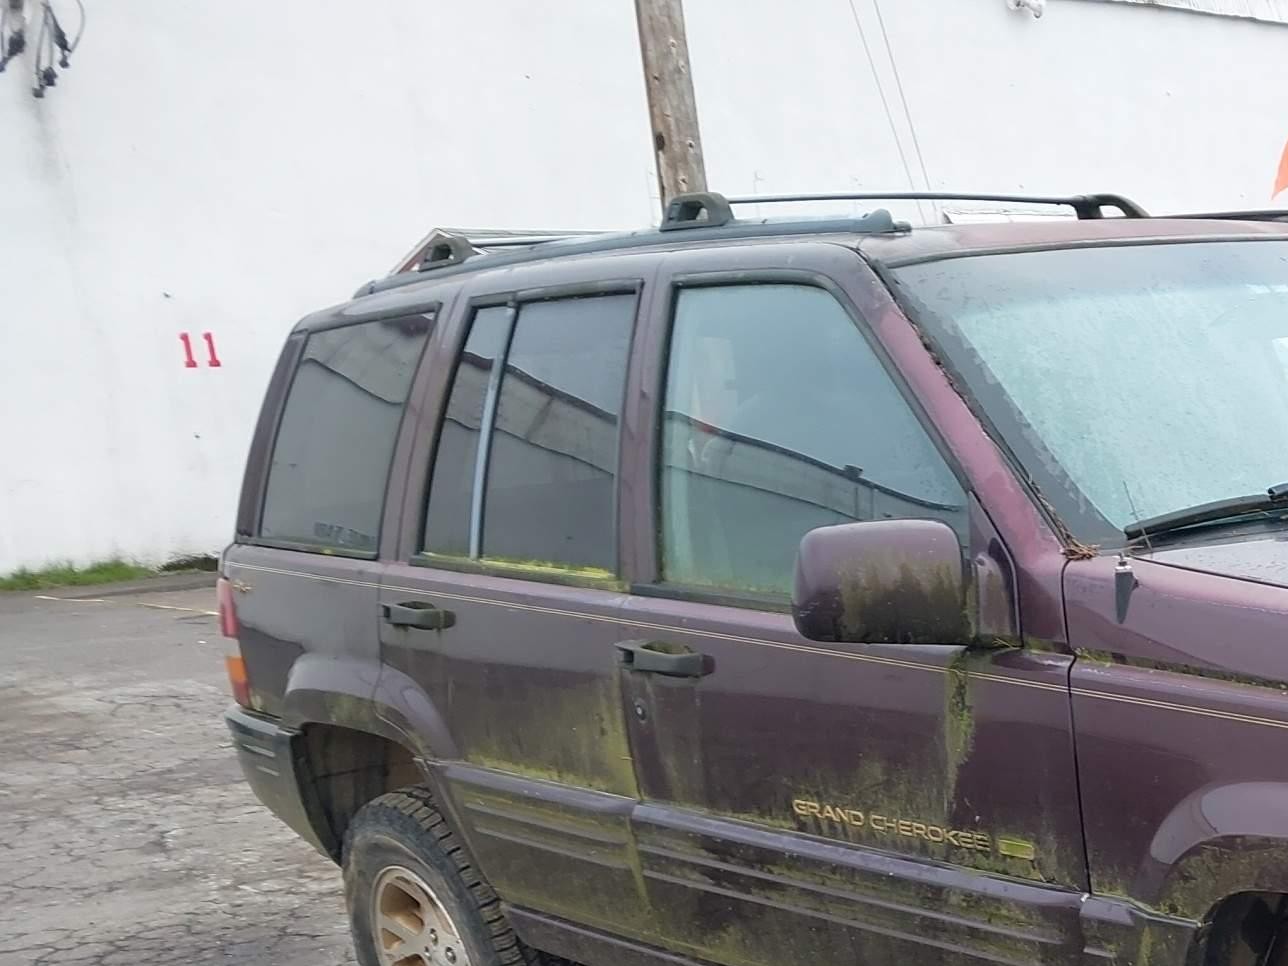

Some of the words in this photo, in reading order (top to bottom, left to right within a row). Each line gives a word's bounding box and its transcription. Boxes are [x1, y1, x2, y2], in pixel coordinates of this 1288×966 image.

[179, 332, 222, 368] 11
[792, 799, 864, 828] GRAND
[871, 814, 991, 851] CHEROKEE
